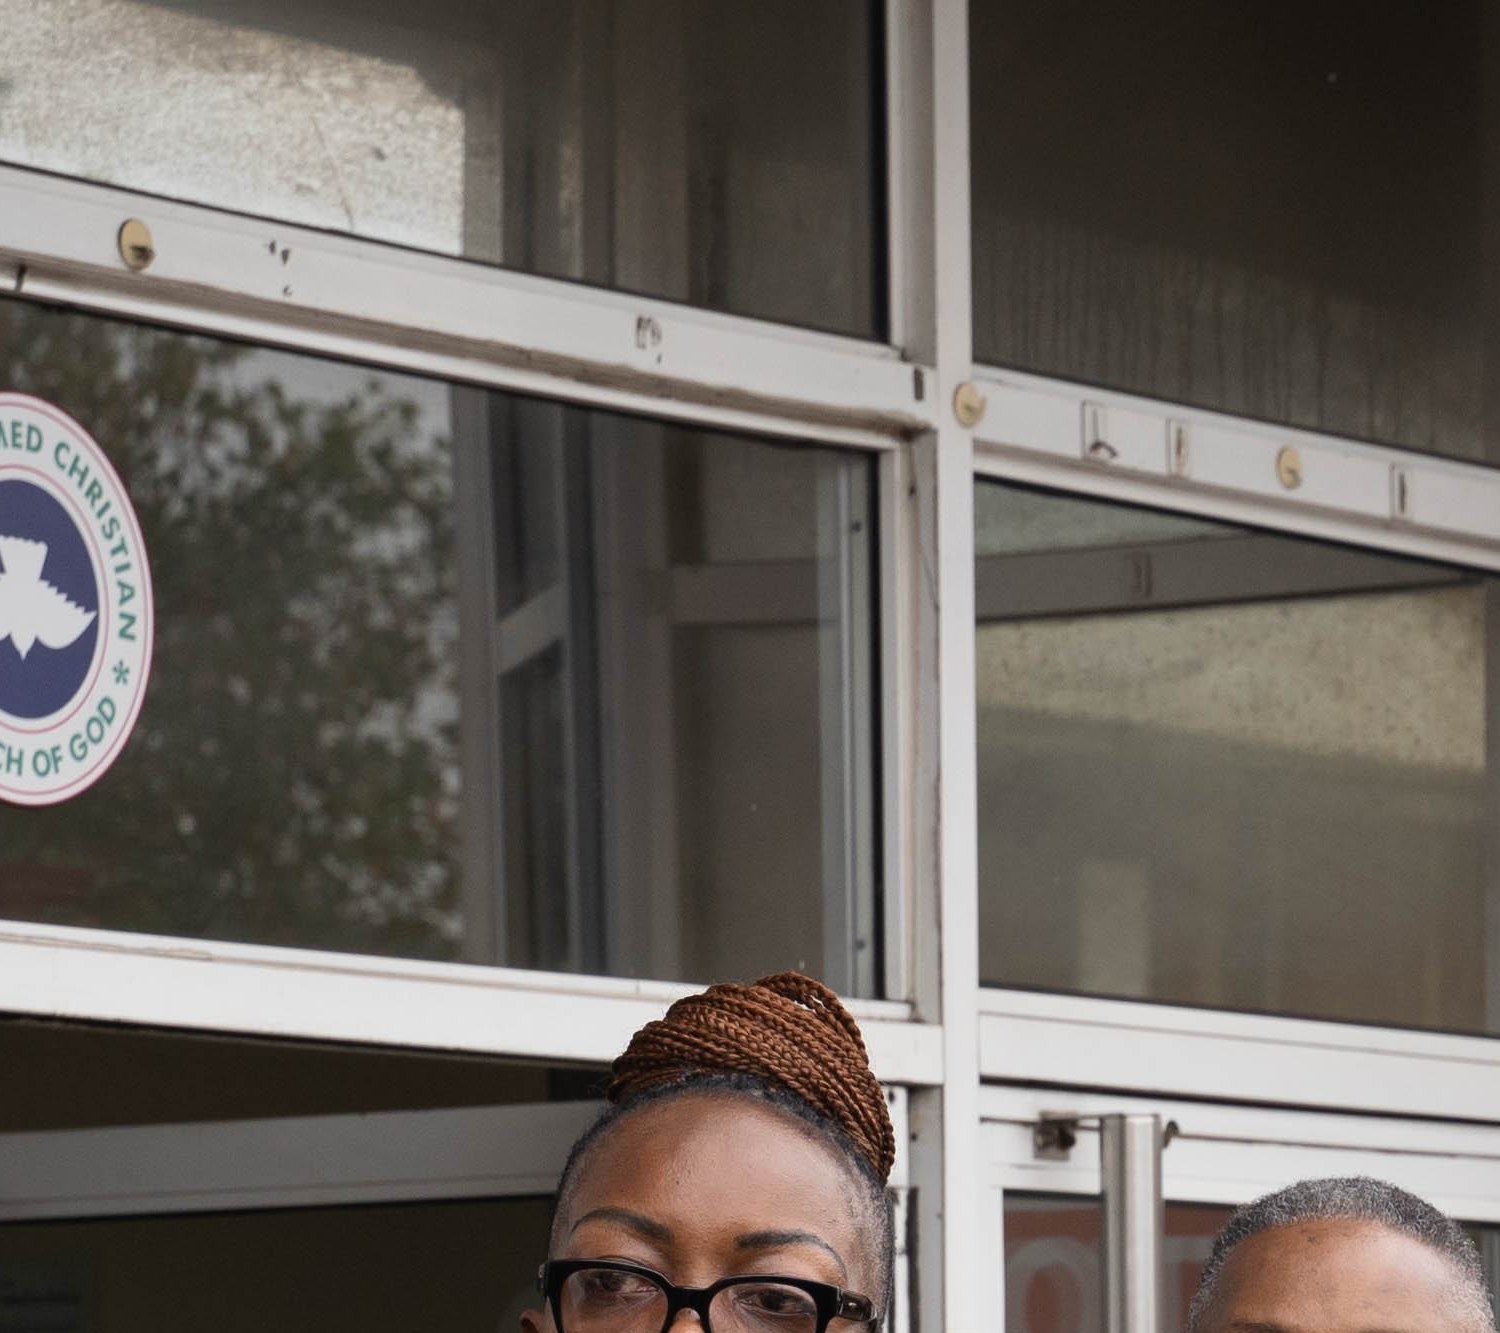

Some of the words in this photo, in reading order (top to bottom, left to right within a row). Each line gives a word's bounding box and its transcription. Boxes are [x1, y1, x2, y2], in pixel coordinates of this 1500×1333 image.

[52, 440, 138, 641] CHRISTIAN
[32, 745, 64, 778] OF
[67, 695, 118, 763] GOD
